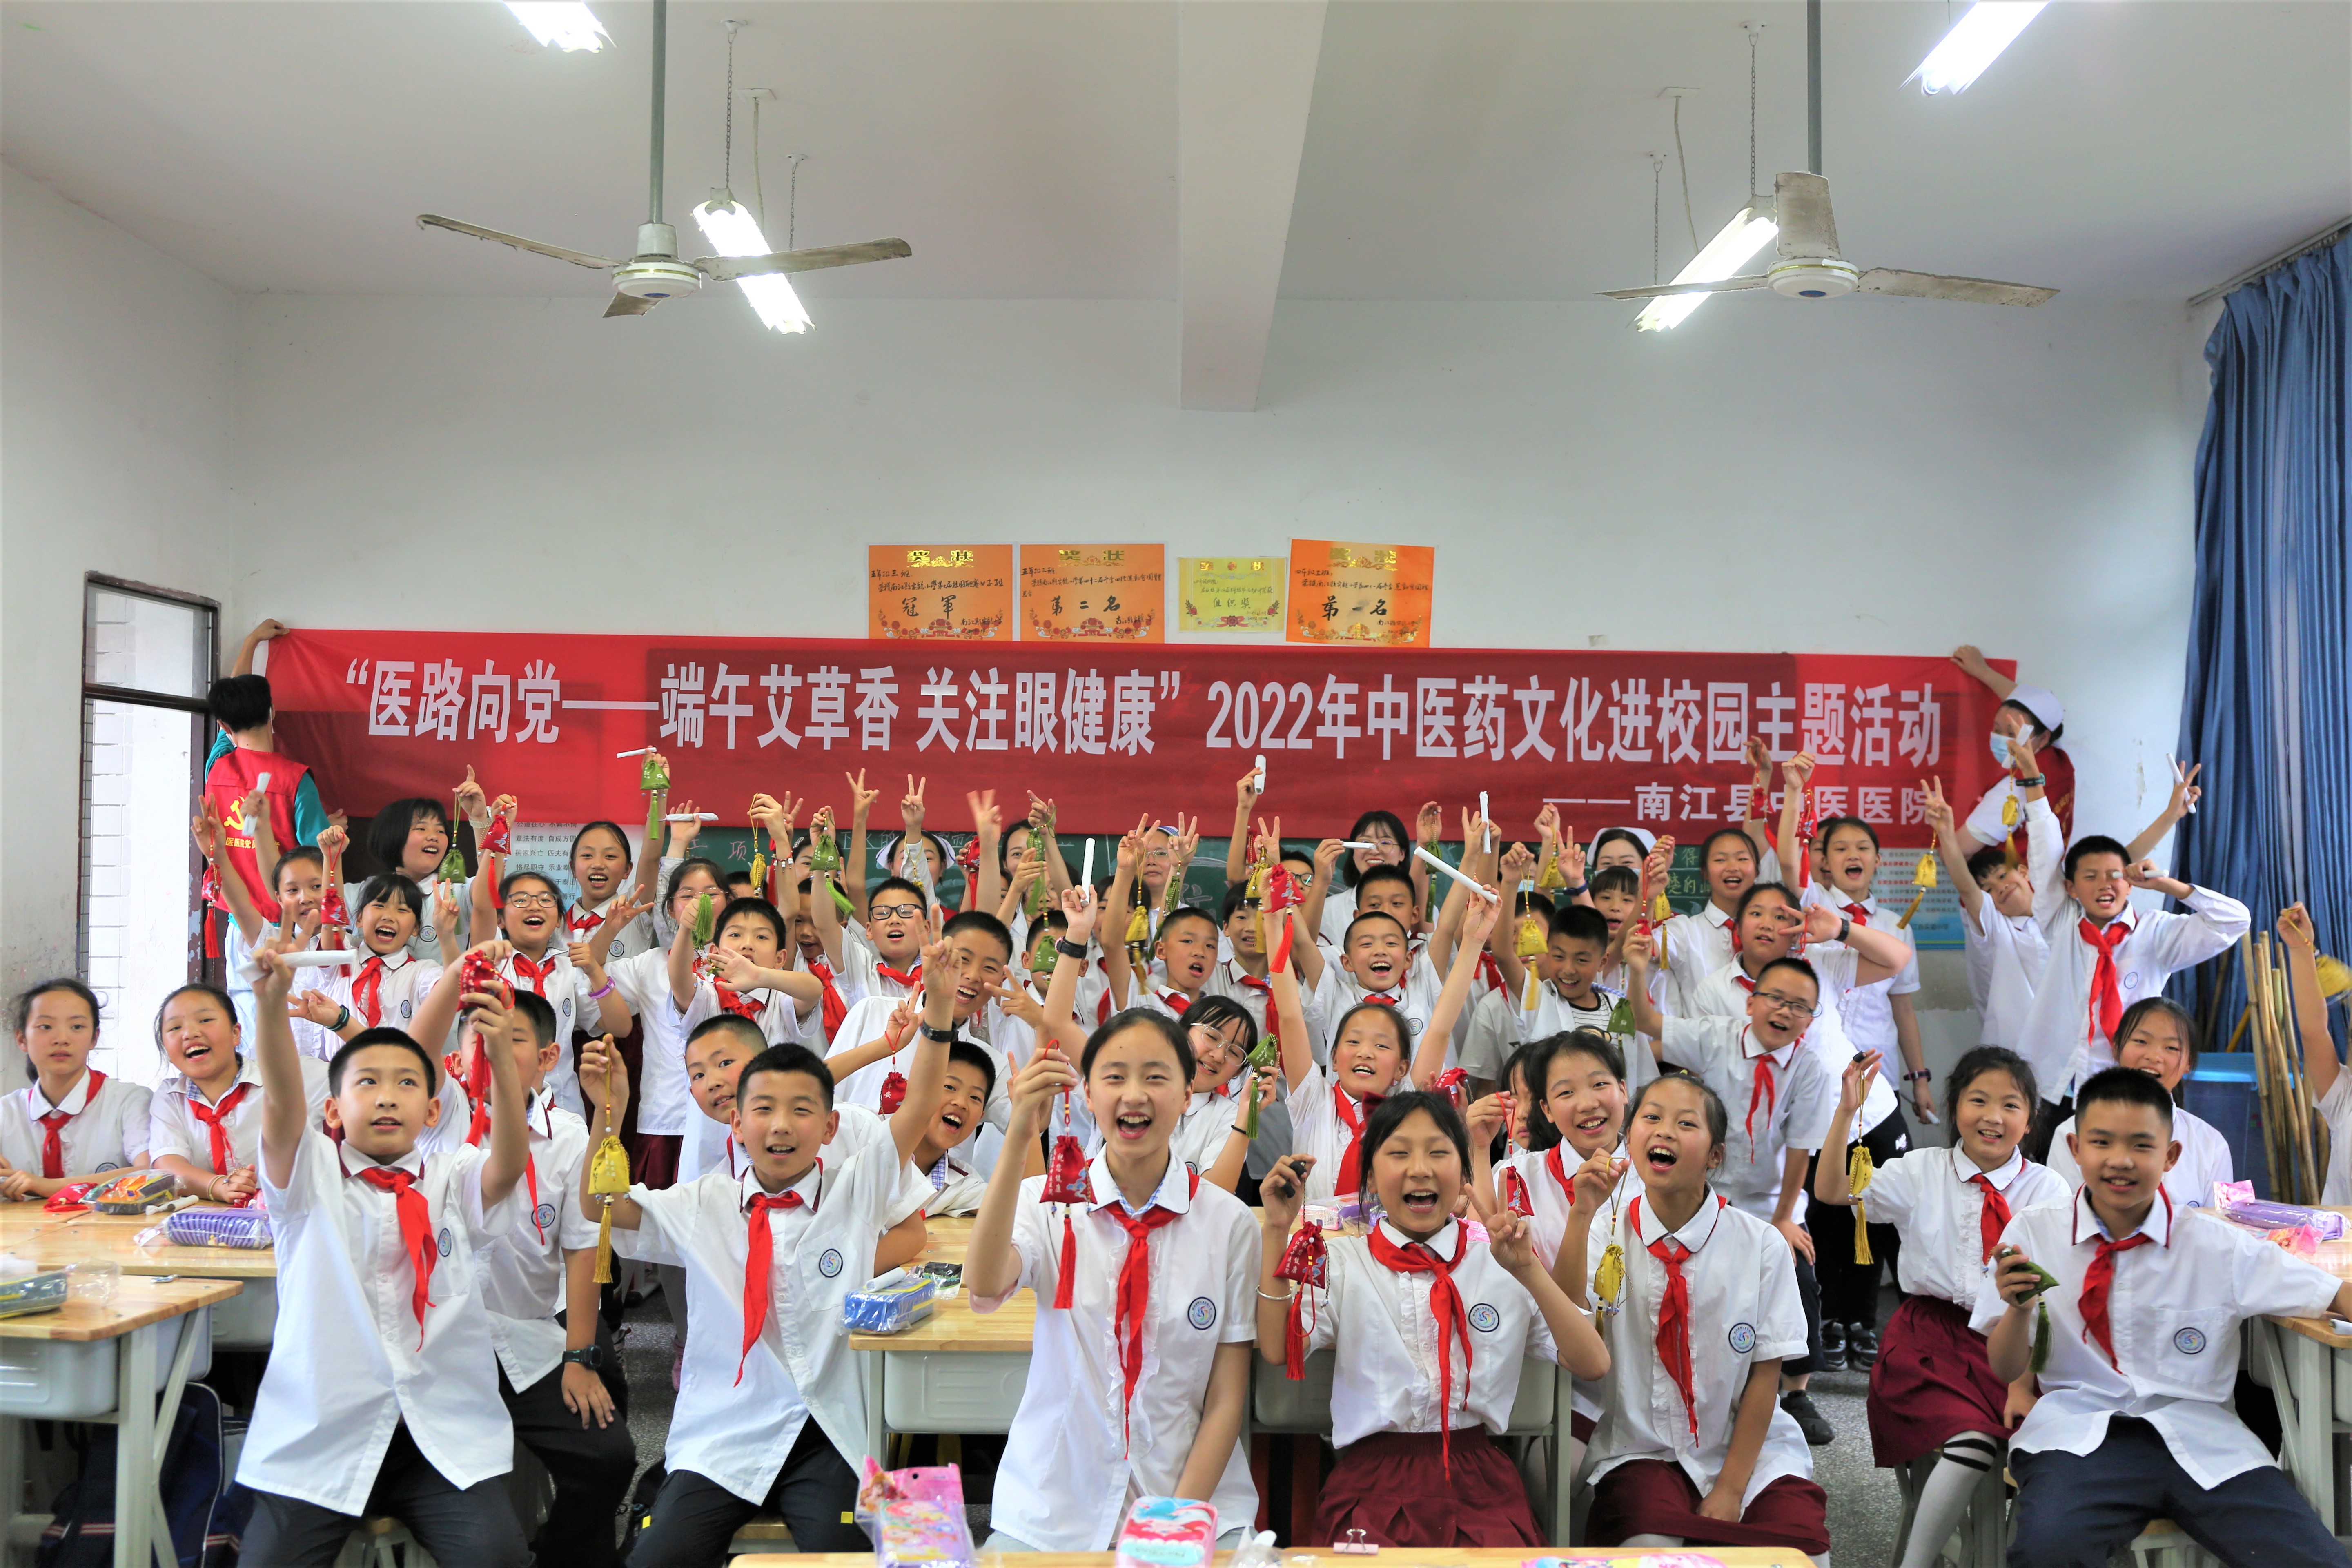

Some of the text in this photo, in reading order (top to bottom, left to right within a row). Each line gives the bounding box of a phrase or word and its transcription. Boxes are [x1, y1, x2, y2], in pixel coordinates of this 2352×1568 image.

[907, 550, 973, 562] 奖状
[1058, 550, 1125, 561] 奖状
[1330, 548, 1397, 563] 奖状
[1051, 595, 1121, 616] 第二名
[1322, 595, 1387, 621] 第一名
[916, 666, 1180, 755] 关注眼健康”
[1206, 673, 1941, 767] 2022年中医药文化进校园主题活动
[884, 1083, 892, 1099] 平安
